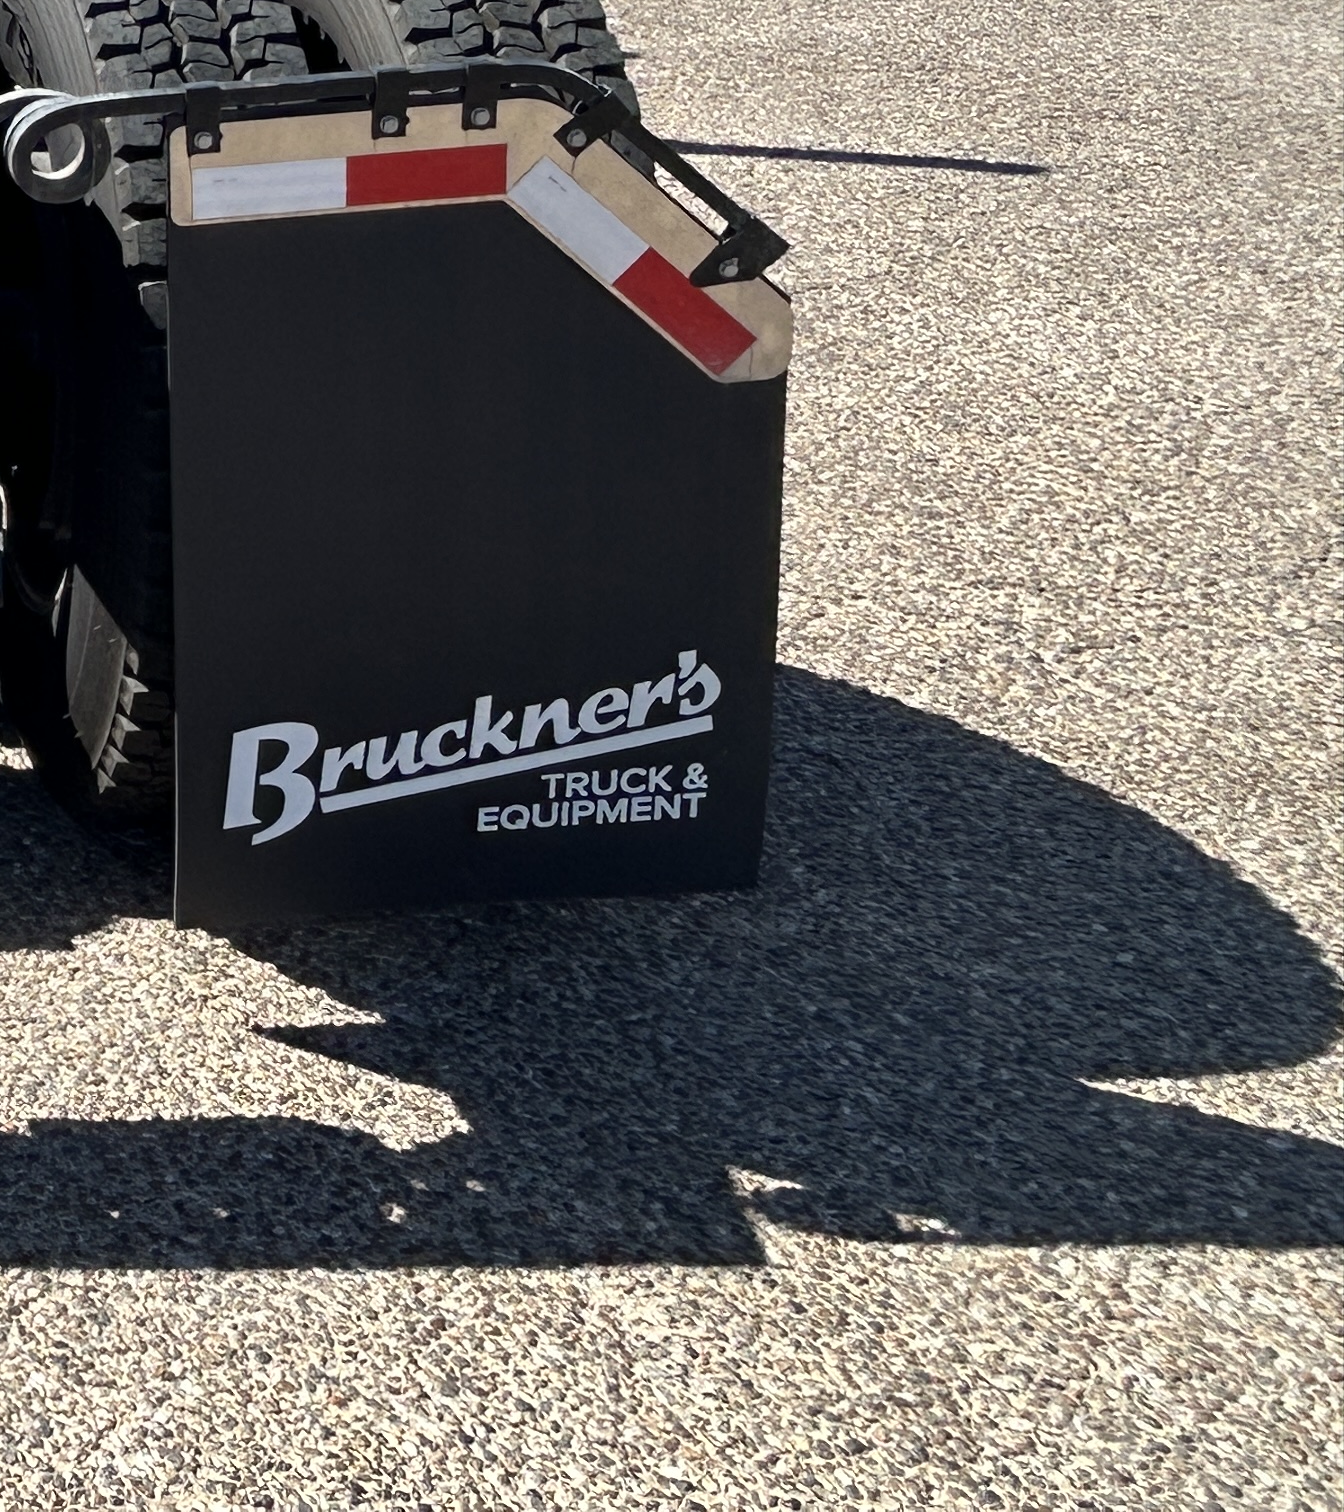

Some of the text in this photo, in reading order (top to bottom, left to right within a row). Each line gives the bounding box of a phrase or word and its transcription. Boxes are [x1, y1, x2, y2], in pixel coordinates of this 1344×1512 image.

[222, 649, 722, 846] Bruckner's
[540, 762, 709, 799] TRUCK &
[476, 791, 707, 832] EQUIPMENT
